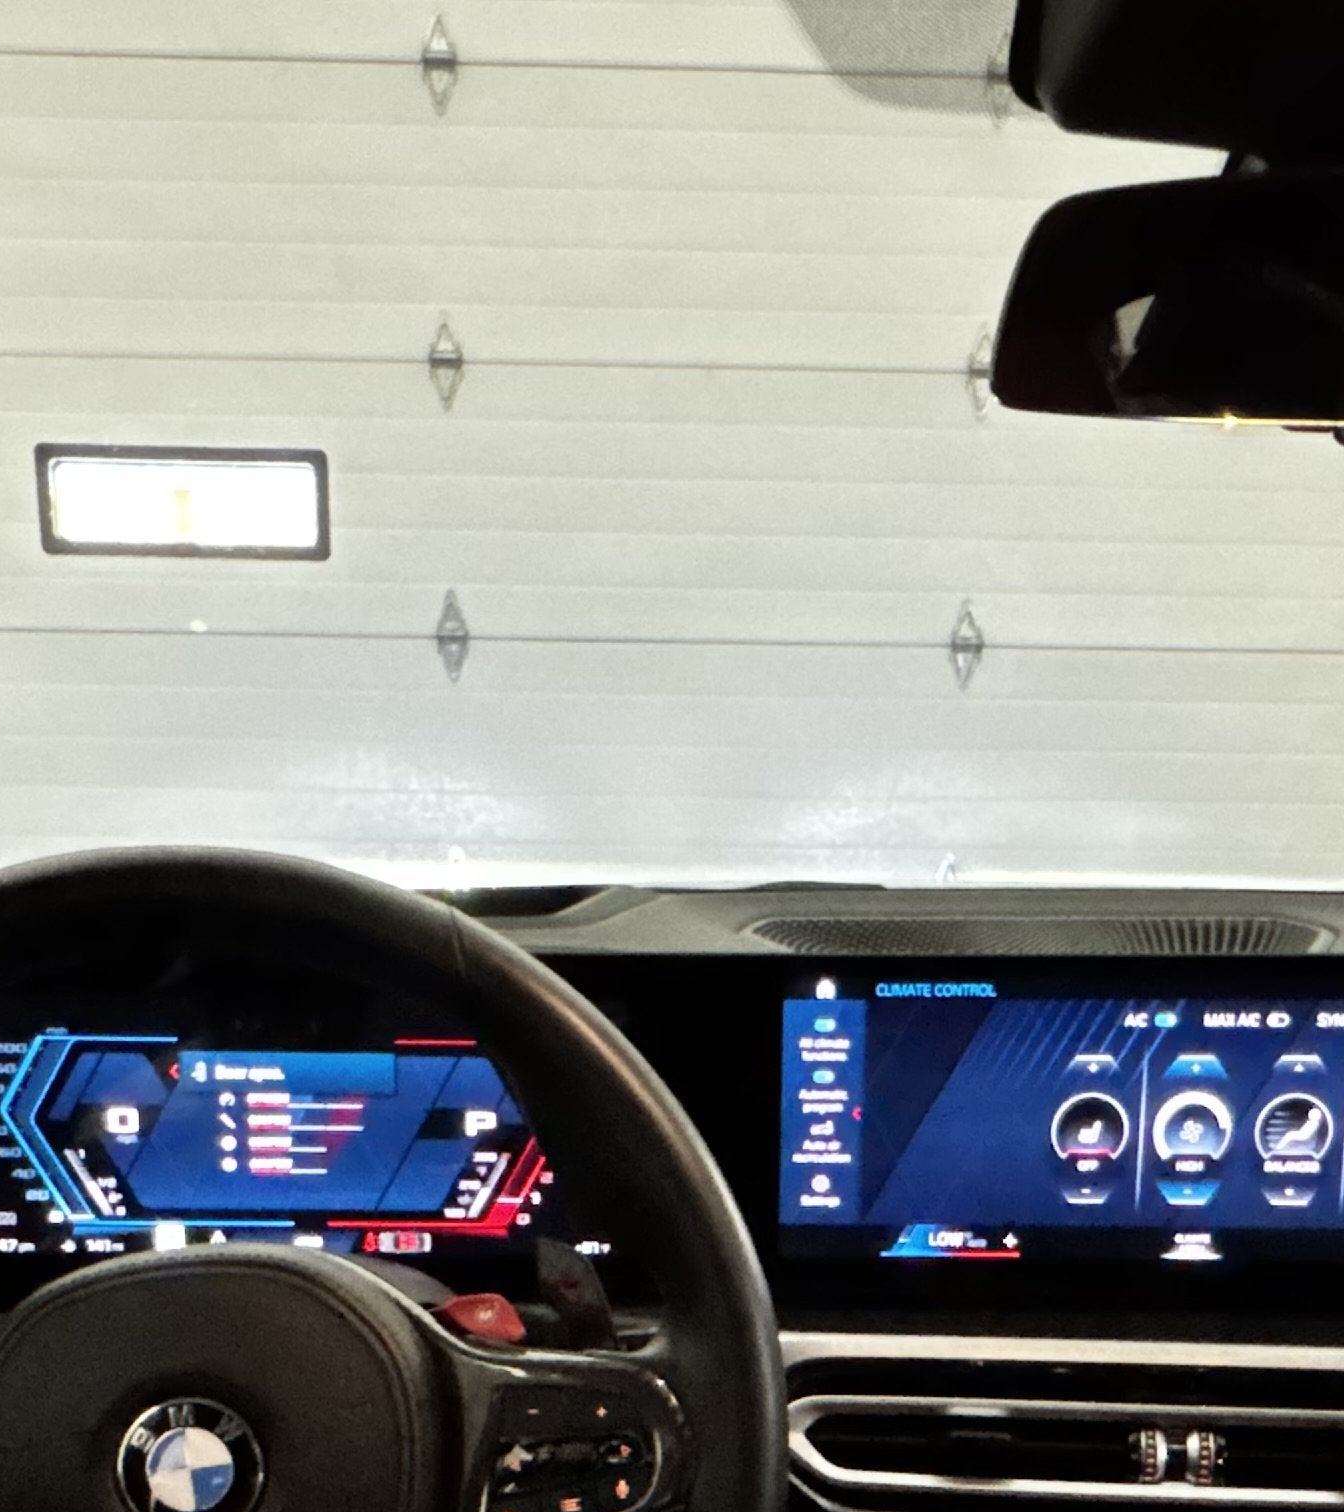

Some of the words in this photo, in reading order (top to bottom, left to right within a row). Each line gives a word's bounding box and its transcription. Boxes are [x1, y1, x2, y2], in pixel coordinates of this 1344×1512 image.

[875, 982, 932, 998] CLIMATE
[934, 982, 997, 998] CONTROL
[1124, 1013, 1149, 1028] A/C
[465, 1111, 497, 1137] P
[928, 1231, 965, 1248] LOW
